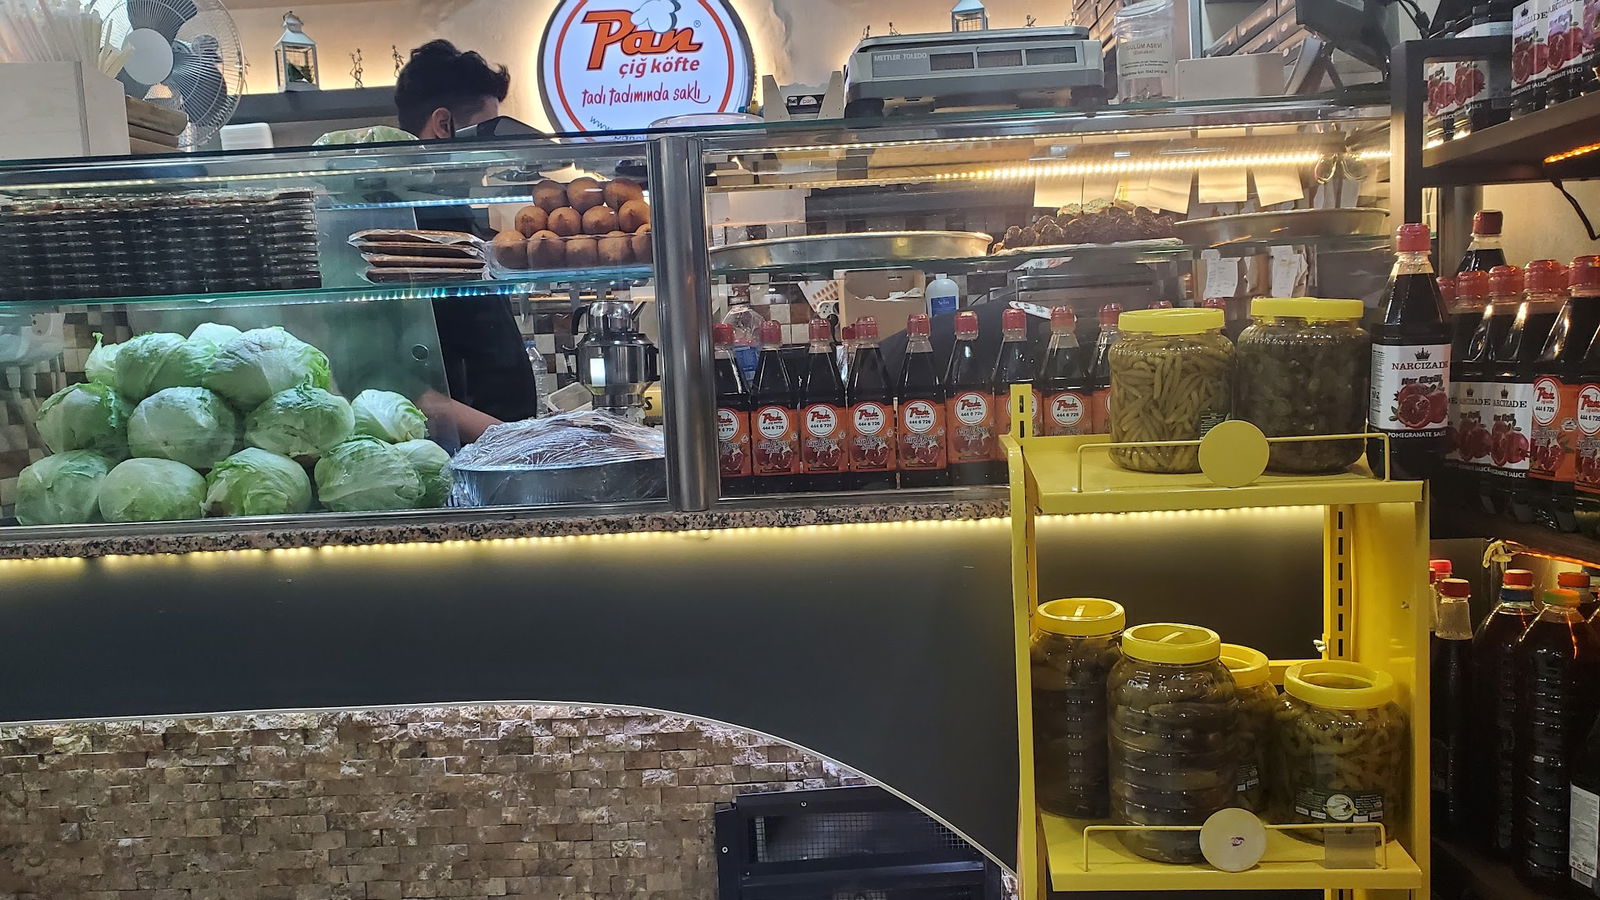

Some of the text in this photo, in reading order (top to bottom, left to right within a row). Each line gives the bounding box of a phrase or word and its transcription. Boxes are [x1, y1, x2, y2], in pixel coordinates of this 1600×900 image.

[581, 9, 703, 70] Pan
[902, 52, 927, 60] TOLEDO
[619, 56, 700, 79] çiğ köfte
[582, 80, 711, 107] tadı tadımında saklı
[1391, 361, 1448, 371] NARCIZADE
[1388, 431, 1432, 439] POMEGRANATE
